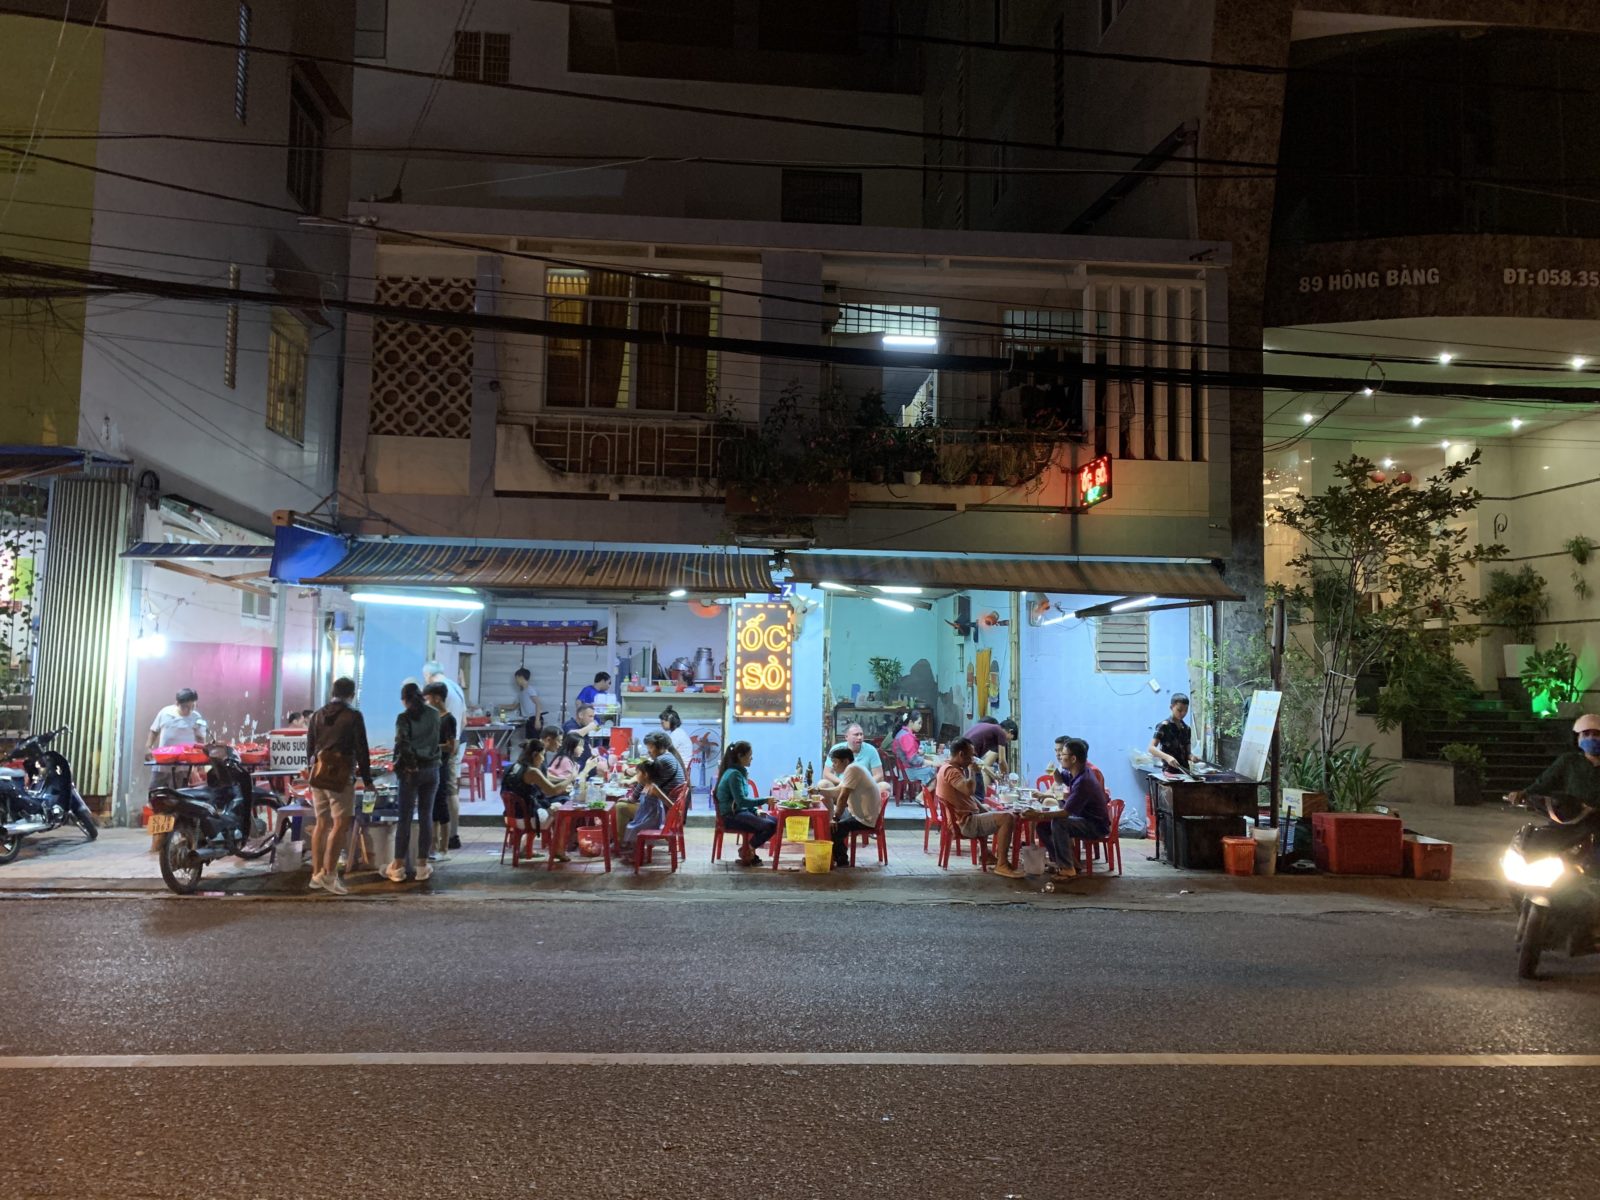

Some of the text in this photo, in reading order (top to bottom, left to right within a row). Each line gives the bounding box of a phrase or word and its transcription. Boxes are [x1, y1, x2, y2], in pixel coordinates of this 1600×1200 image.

[1298, 276, 1323, 293] 89
[740, 612, 788, 652] ỐC
[742, 654, 786, 691] SÒ
[272, 756, 308, 766] YAOUR
